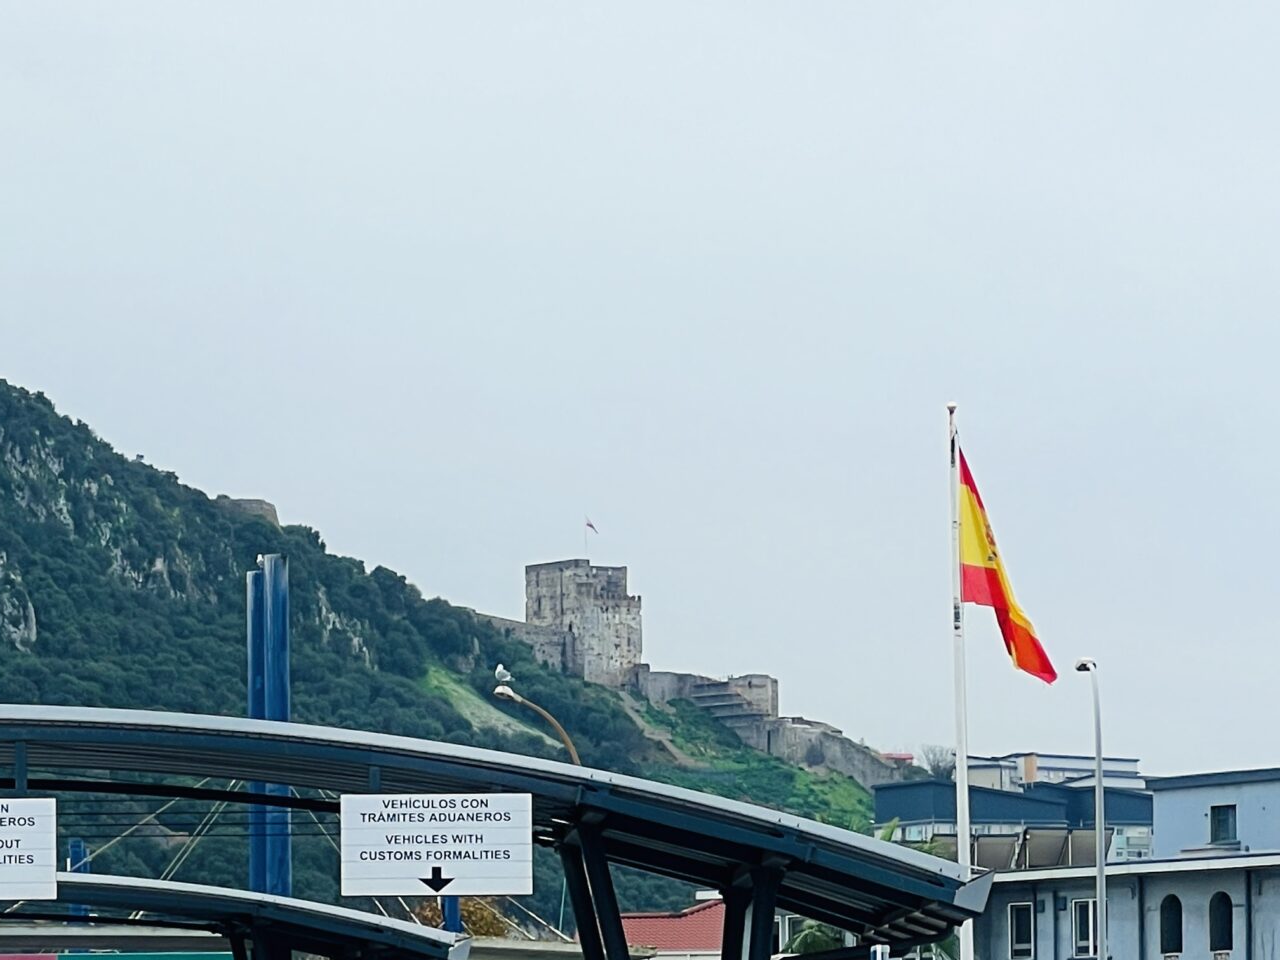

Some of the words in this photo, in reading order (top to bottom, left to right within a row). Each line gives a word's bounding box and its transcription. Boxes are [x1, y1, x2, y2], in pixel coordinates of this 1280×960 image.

[382, 797, 457, 809] VEHÍCULOS
[461, 799, 489, 808] CON
[360, 810, 425, 822] TRÁMITES
[429, 812, 512, 822] ADUANEROS
[385, 834, 448, 845] VEHICLES
[451, 834, 483, 844] WITH
[359, 850, 422, 861] CUSTOMS
[426, 850, 510, 860] FORMALITIES
